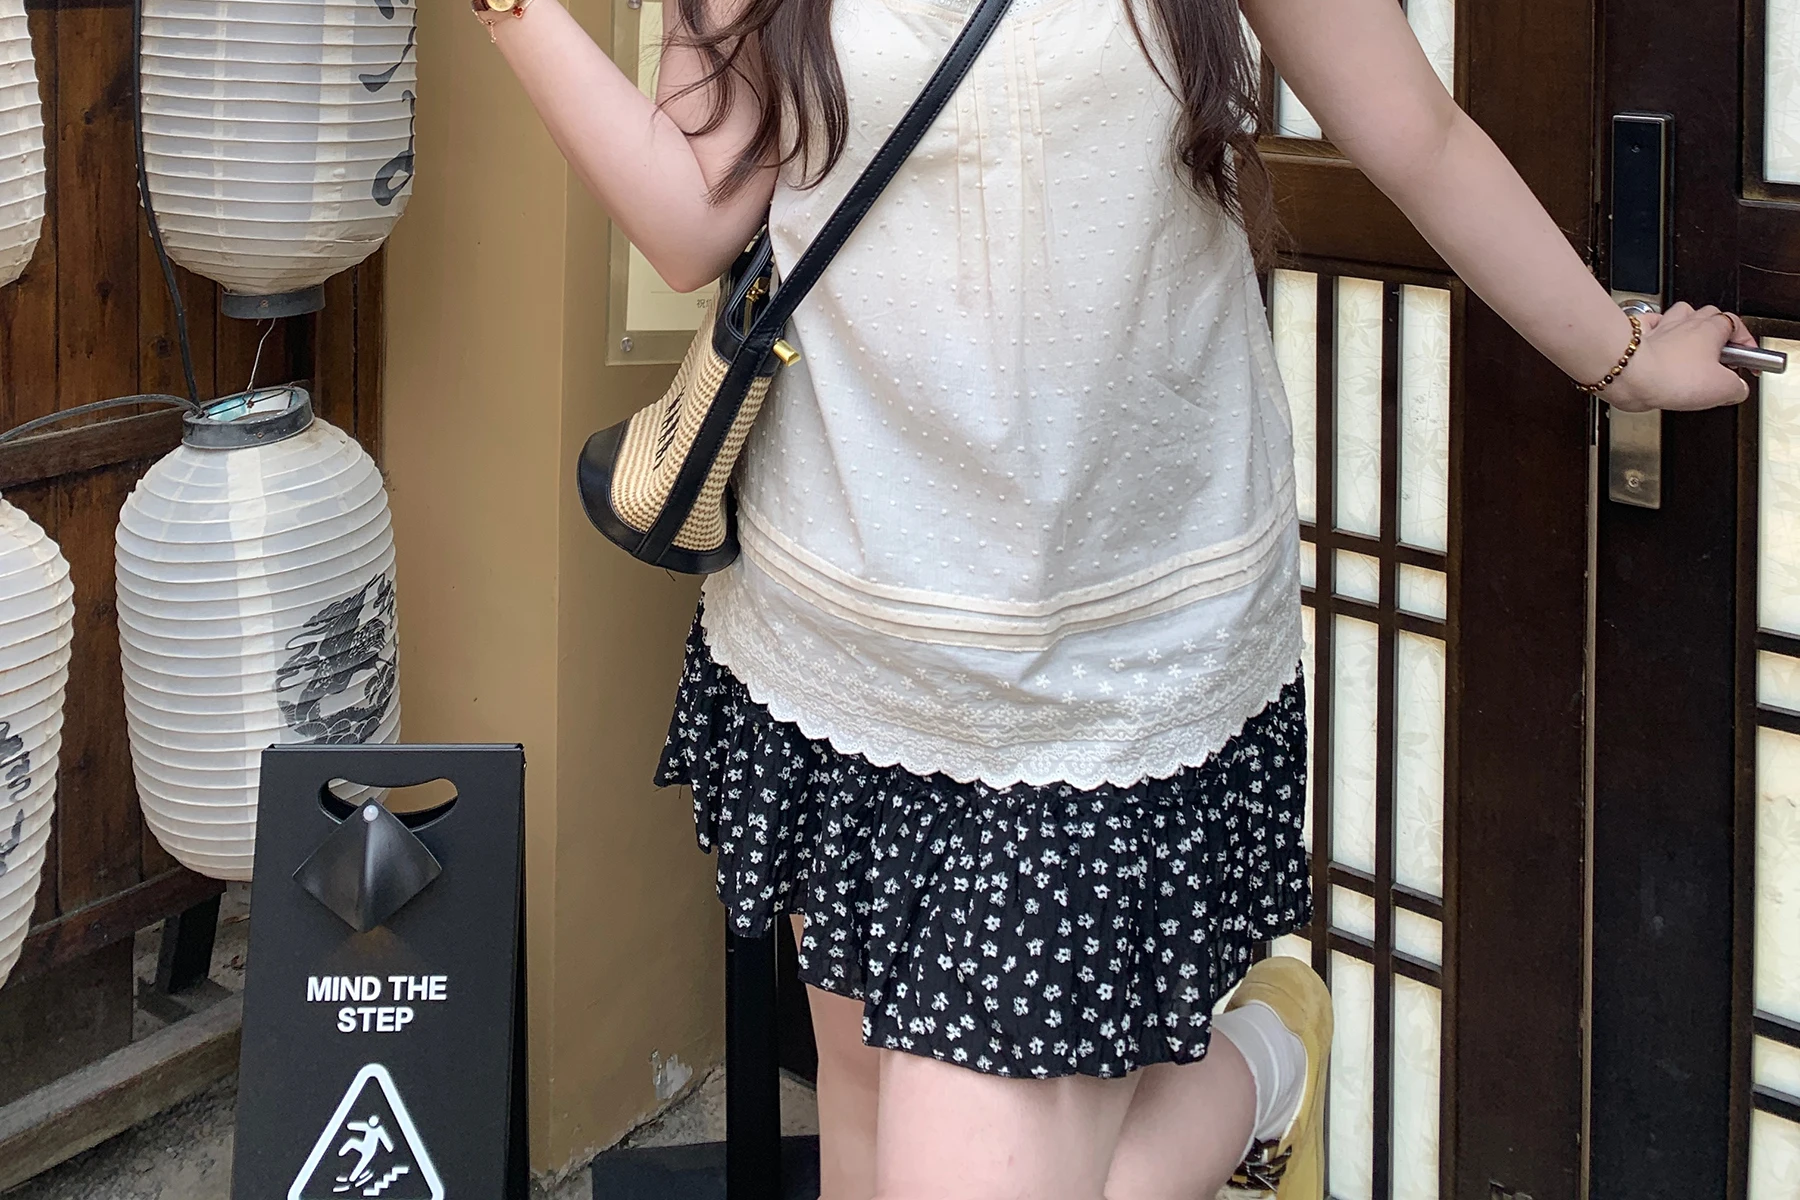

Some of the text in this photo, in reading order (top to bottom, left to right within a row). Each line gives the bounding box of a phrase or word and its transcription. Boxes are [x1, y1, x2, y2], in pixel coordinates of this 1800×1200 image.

[306, 976, 448, 1001] MIND THE
[337, 1006, 414, 1033] STEP
